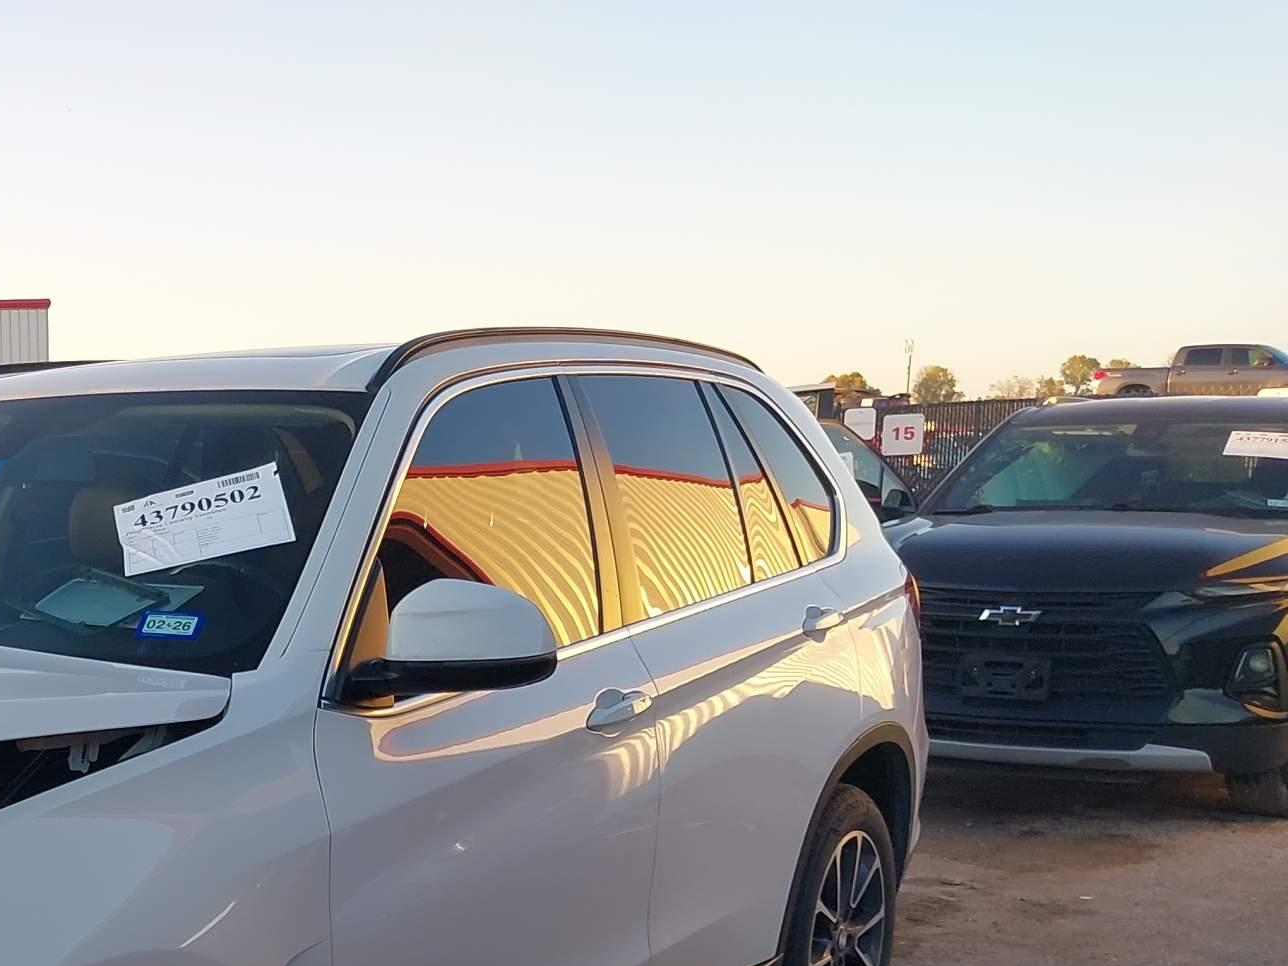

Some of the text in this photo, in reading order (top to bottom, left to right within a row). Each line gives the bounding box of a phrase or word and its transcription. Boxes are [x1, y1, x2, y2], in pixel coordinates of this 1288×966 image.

[892, 426, 915, 441] 15
[133, 485, 262, 527] 43790502
[146, 619, 192, 632] 02 26
